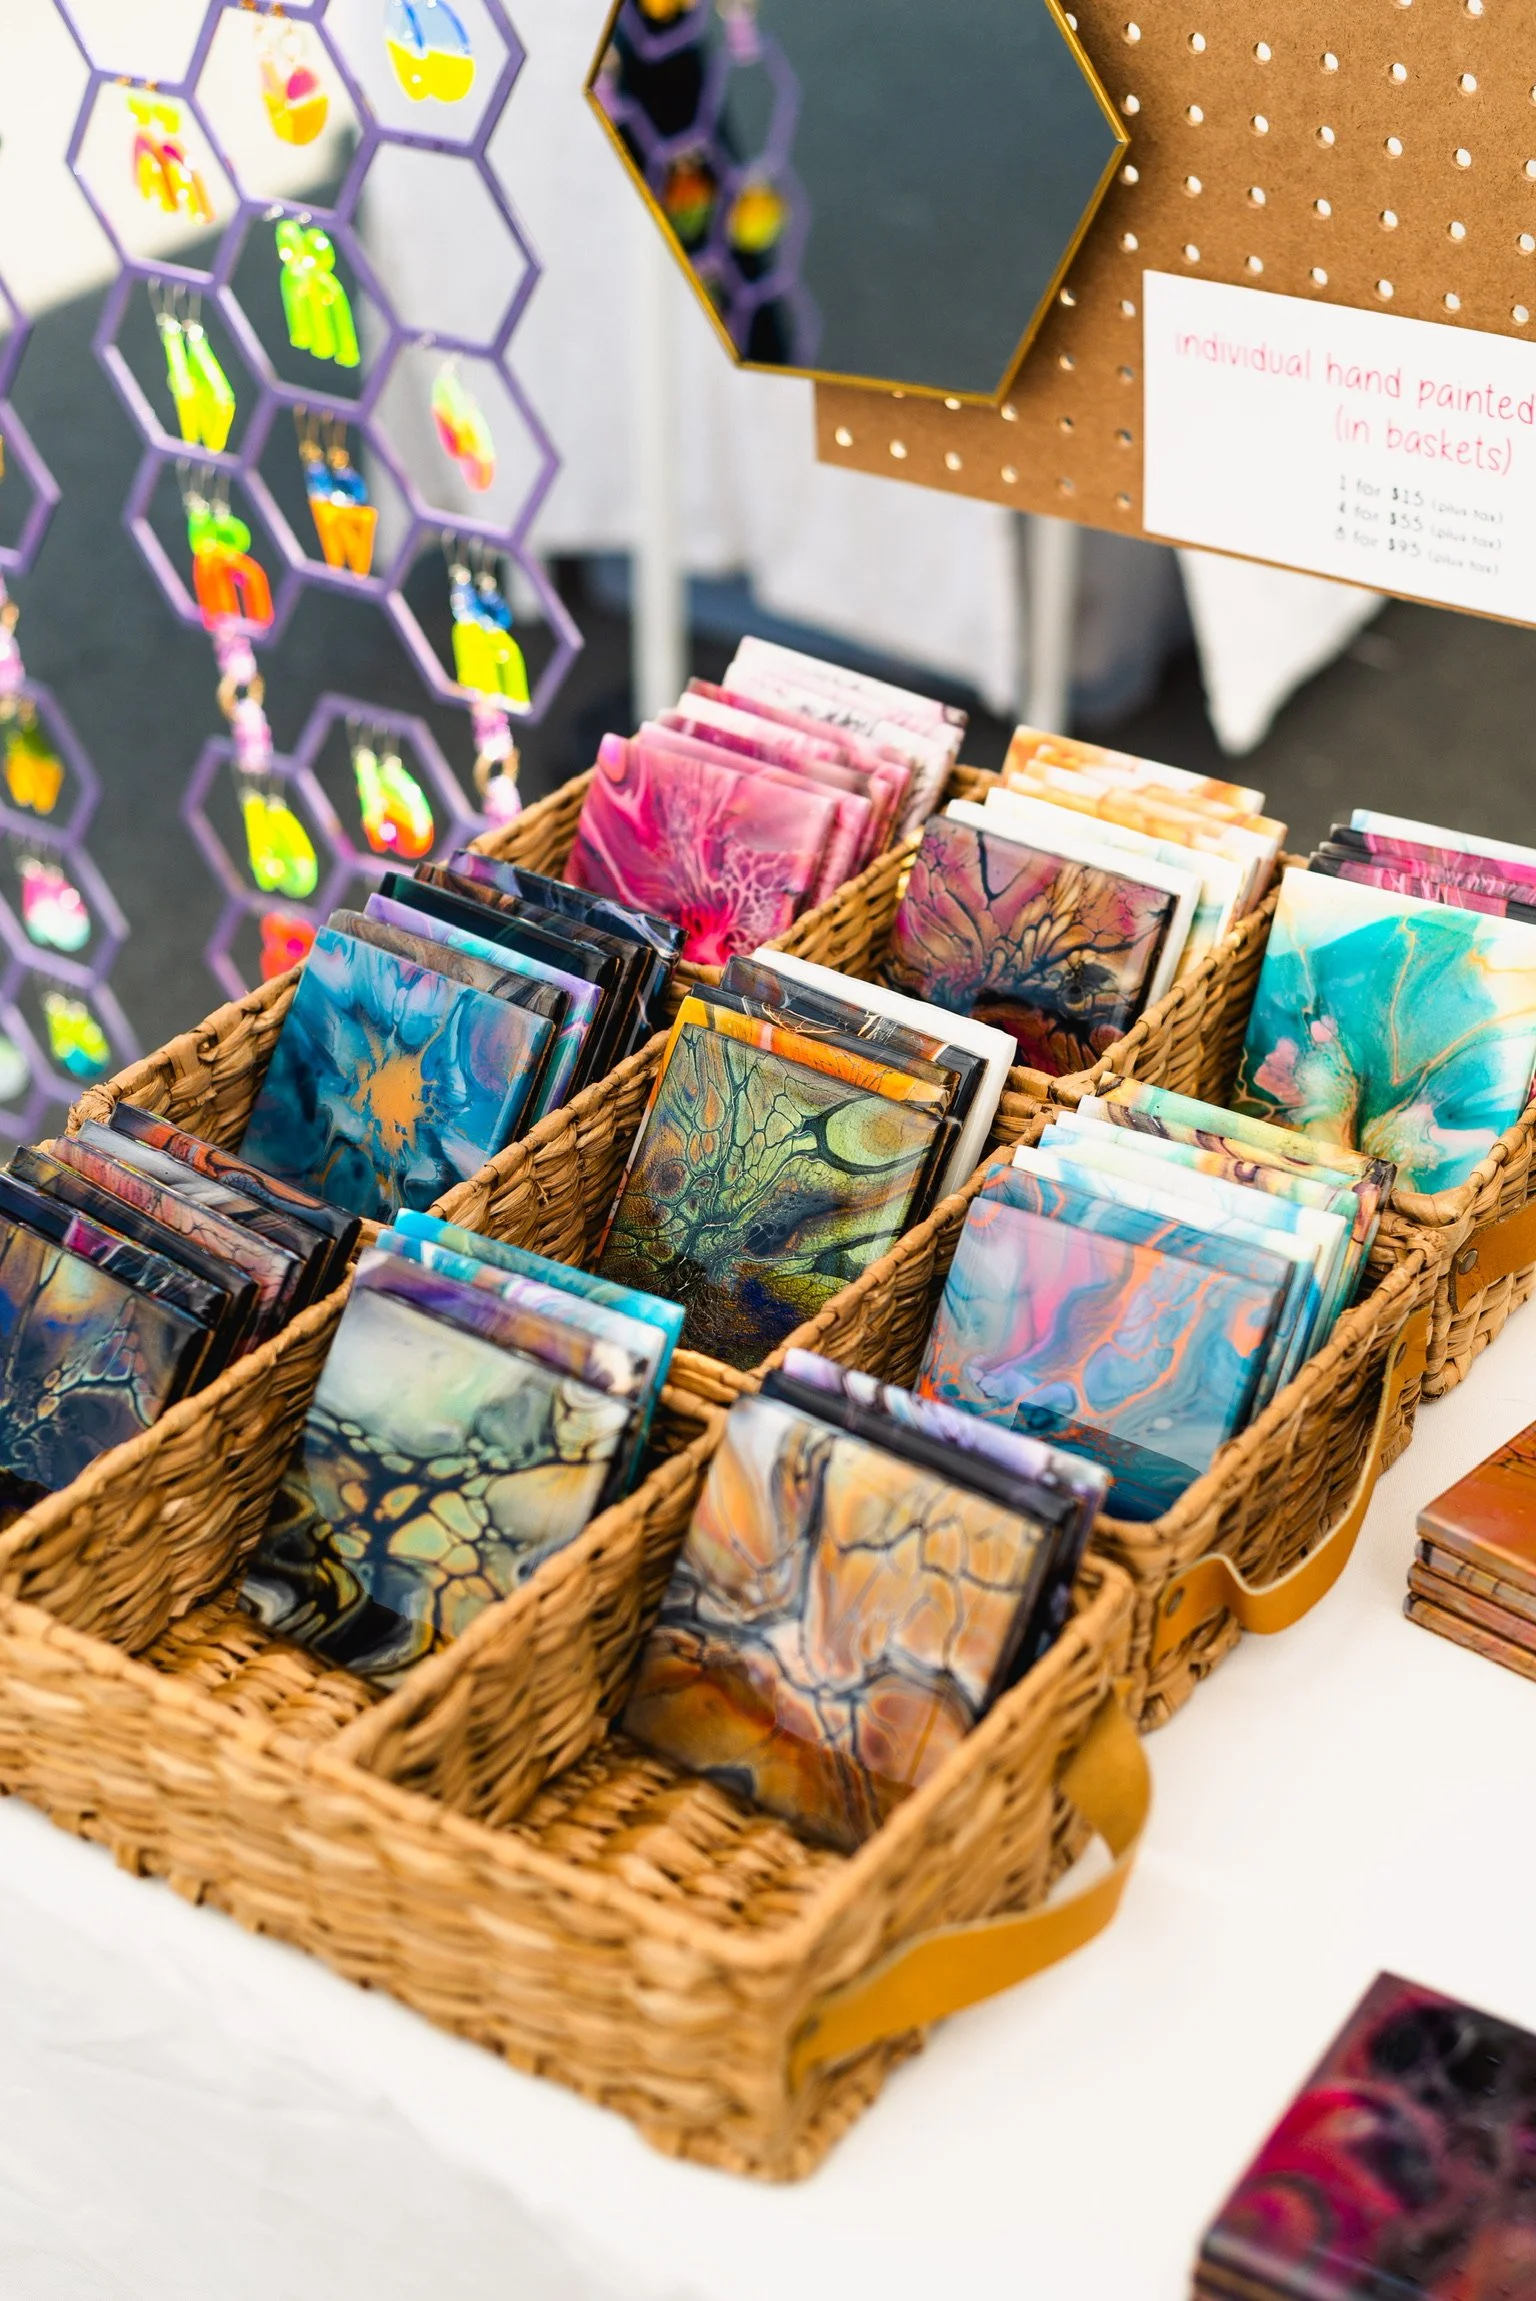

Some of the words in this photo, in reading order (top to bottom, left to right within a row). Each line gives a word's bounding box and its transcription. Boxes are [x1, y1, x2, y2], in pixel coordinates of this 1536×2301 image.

[1175, 331, 1311, 380] individual
[1326, 352, 1402, 399] hand
[1417, 379, 1535, 426] painted
[1335, 404, 1369, 444] (in
[1387, 418, 1512, 476] baskets)
[1355, 478, 1382, 497] for
[1391, 487, 1425, 507] $15
[1353, 505, 1380, 522] for
[1352, 529, 1380, 549] for
